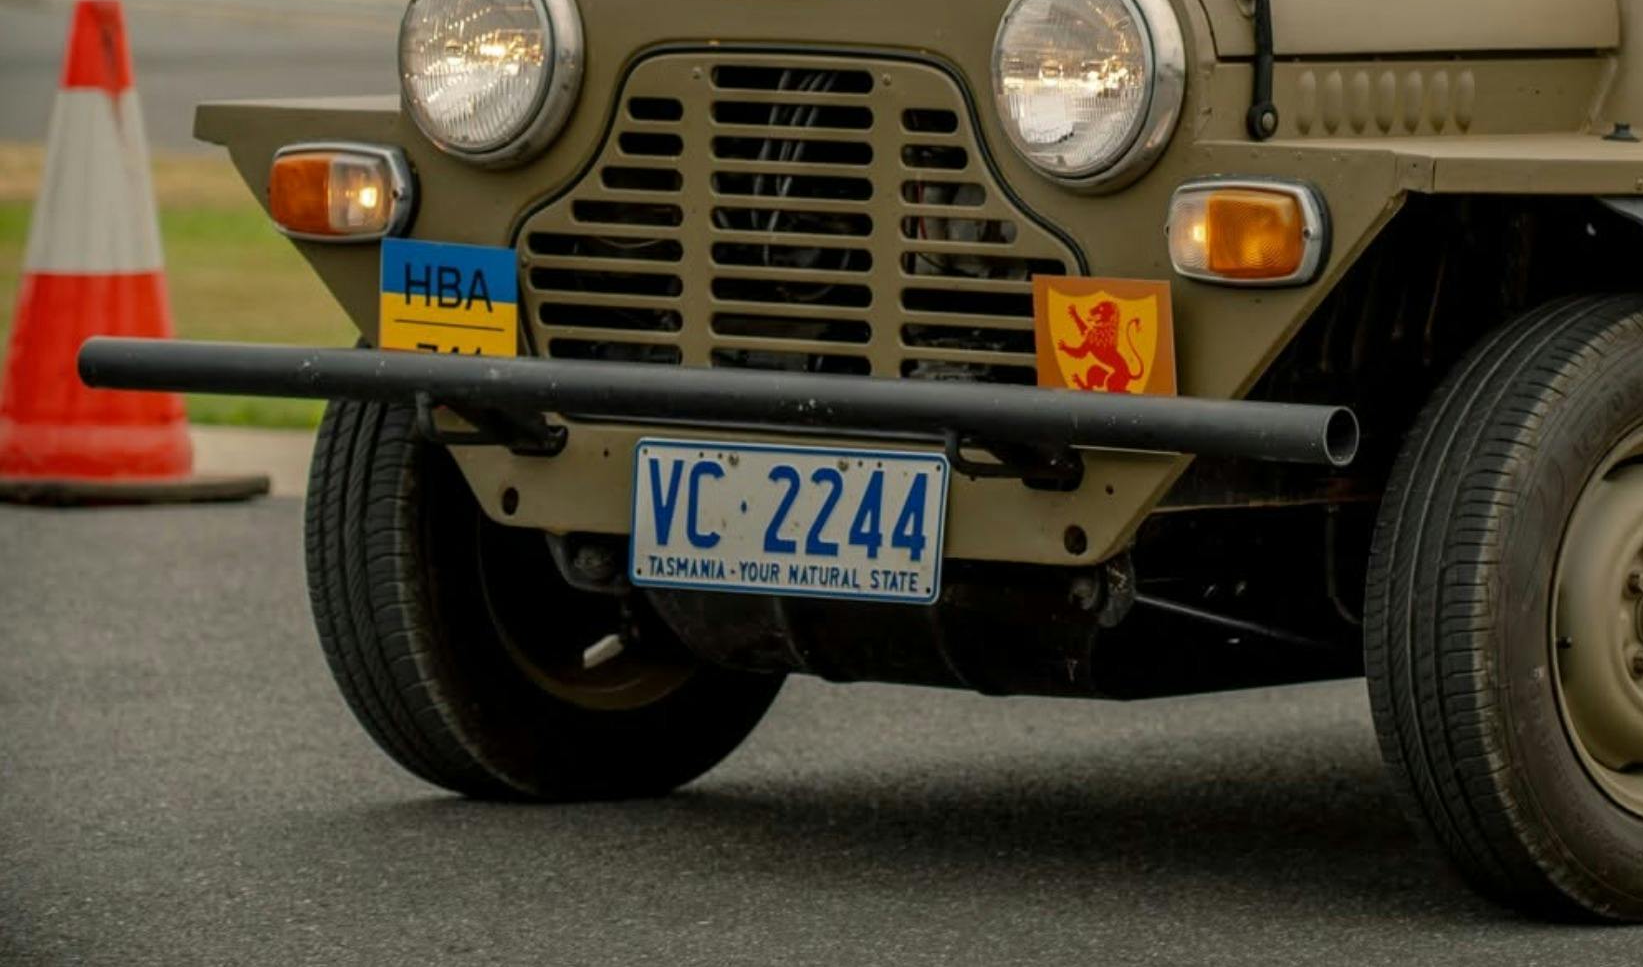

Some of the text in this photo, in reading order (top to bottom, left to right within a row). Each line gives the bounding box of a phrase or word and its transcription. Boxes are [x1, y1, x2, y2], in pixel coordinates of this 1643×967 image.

[404, 262, 493, 313] HBA
[648, 458, 928, 562] VC 2244
[648, 555, 725, 579] TASMANIA
[738, 561, 779, 581] YOUR
[789, 565, 860, 589] NATURAL
[870, 570, 918, 592] STATE
